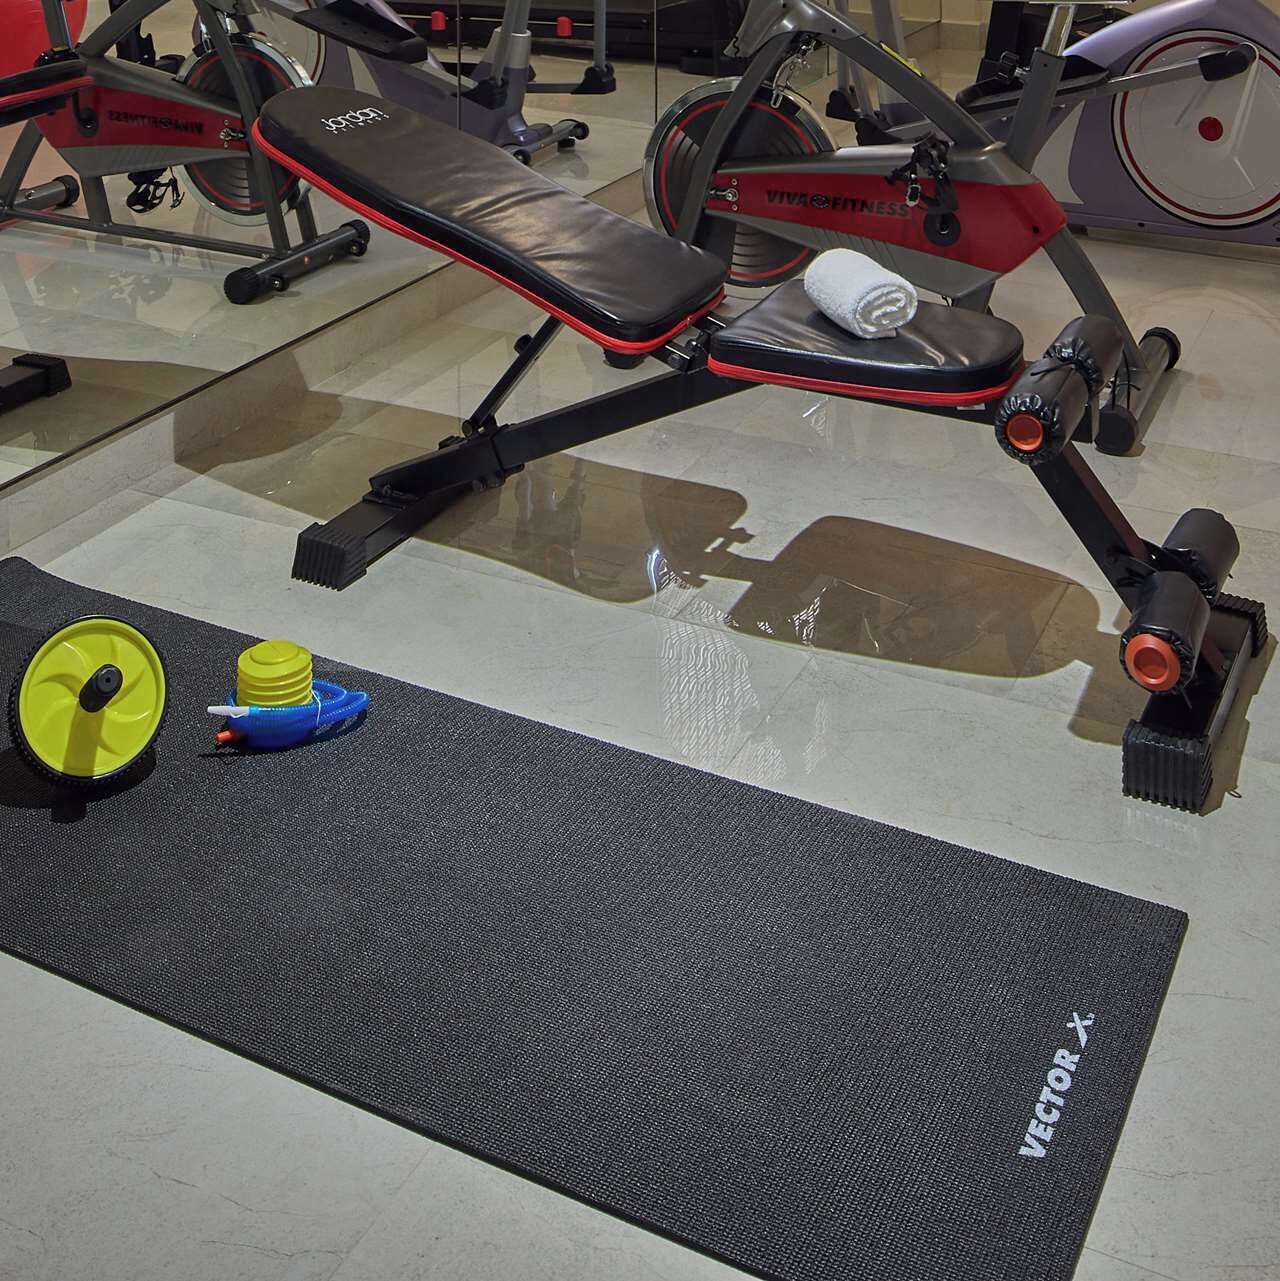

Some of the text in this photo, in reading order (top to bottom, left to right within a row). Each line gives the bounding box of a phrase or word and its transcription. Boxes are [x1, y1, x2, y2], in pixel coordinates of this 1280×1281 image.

[767, 190, 911, 217] VIVA FITNESS
[1019, 1012, 1095, 1158] VECTOR X
